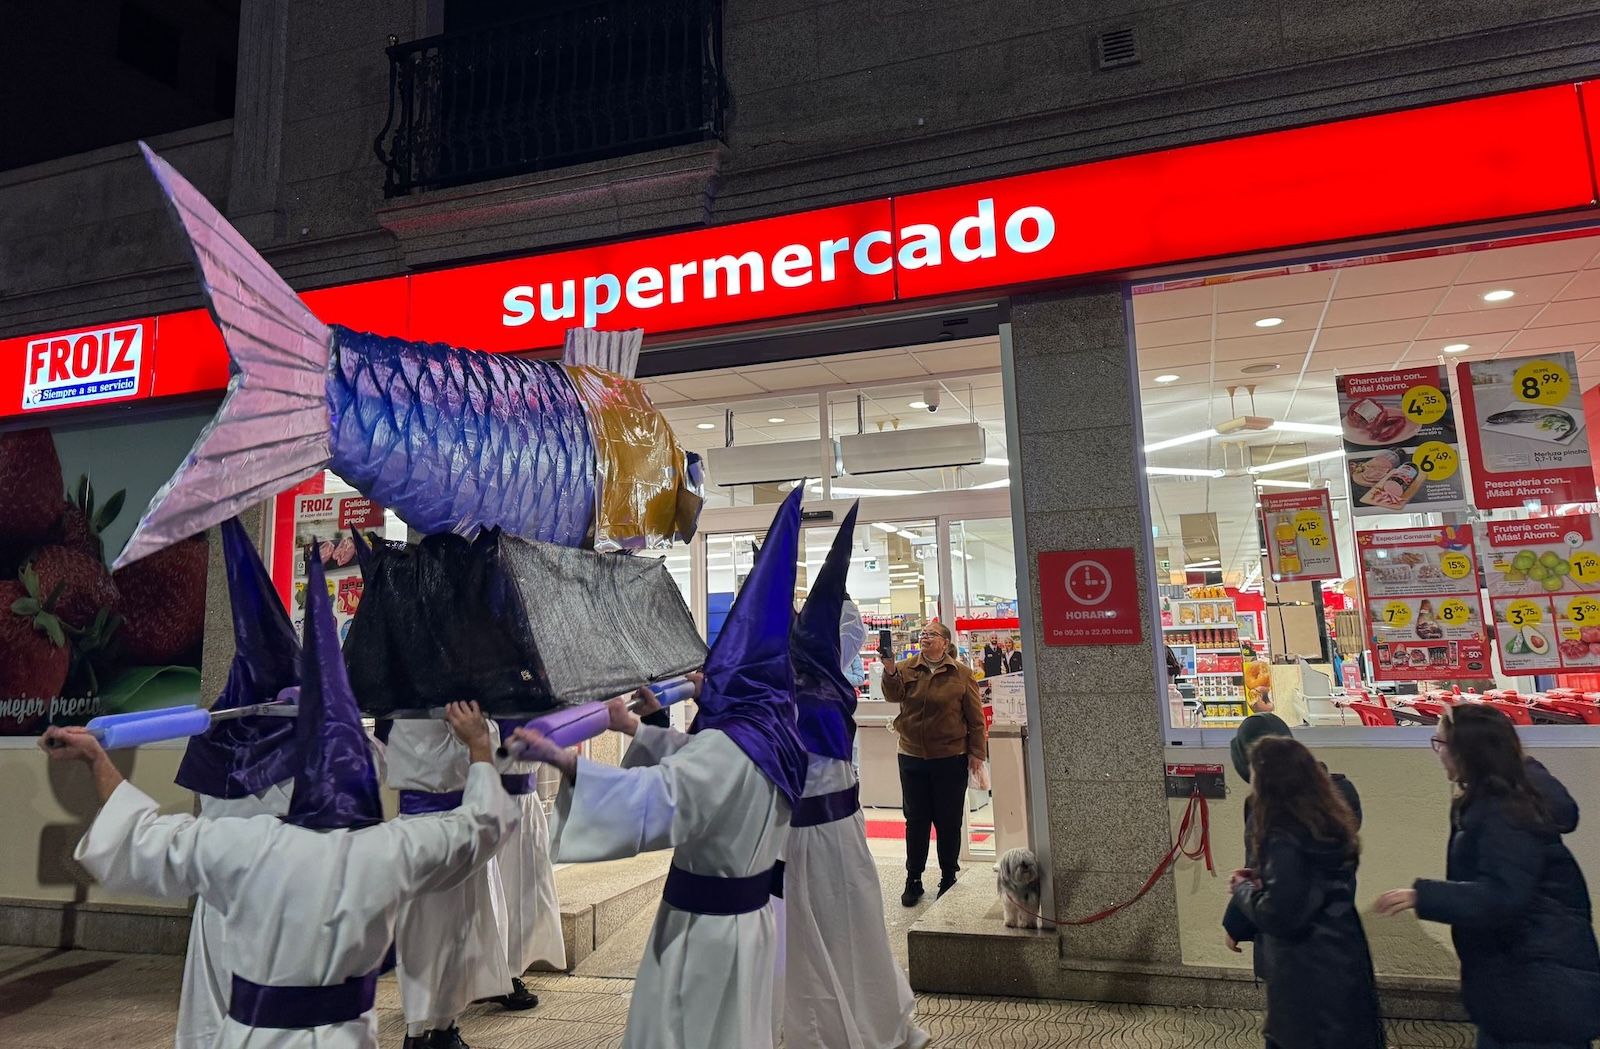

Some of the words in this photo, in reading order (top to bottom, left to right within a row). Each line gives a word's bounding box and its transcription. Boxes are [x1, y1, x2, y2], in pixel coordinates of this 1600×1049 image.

[502, 197, 1056, 328] supermercado
[29, 328, 138, 385] FROIZ
[1349, 374, 1401, 386] Charcutería
[42, 387, 77, 400] Siempre
[87, 385, 97, 394] su
[100, 379, 134, 391] servicio
[1350, 386, 1375, 394] ¡Más!
[1376, 383, 1409, 391] Ahorro.
[1484, 478, 1541, 488] Pescadería
[1486, 489, 1514, 500] ¡Más!
[1516, 488, 1554, 496] Ahorro.
[300, 498, 334, 513] FROIZ
[344, 500, 370, 508] Calidad
[352, 508, 371, 516] mejor
[344, 516, 366, 526] precio
[1493, 523, 1531, 533] Frutería
[1494, 534, 1521, 544] ¡Más!
[1523, 531, 1560, 540] Ahorro.
[1448, 561, 1466, 569] 15%
[1066, 610, 1117, 620] HORARIO
